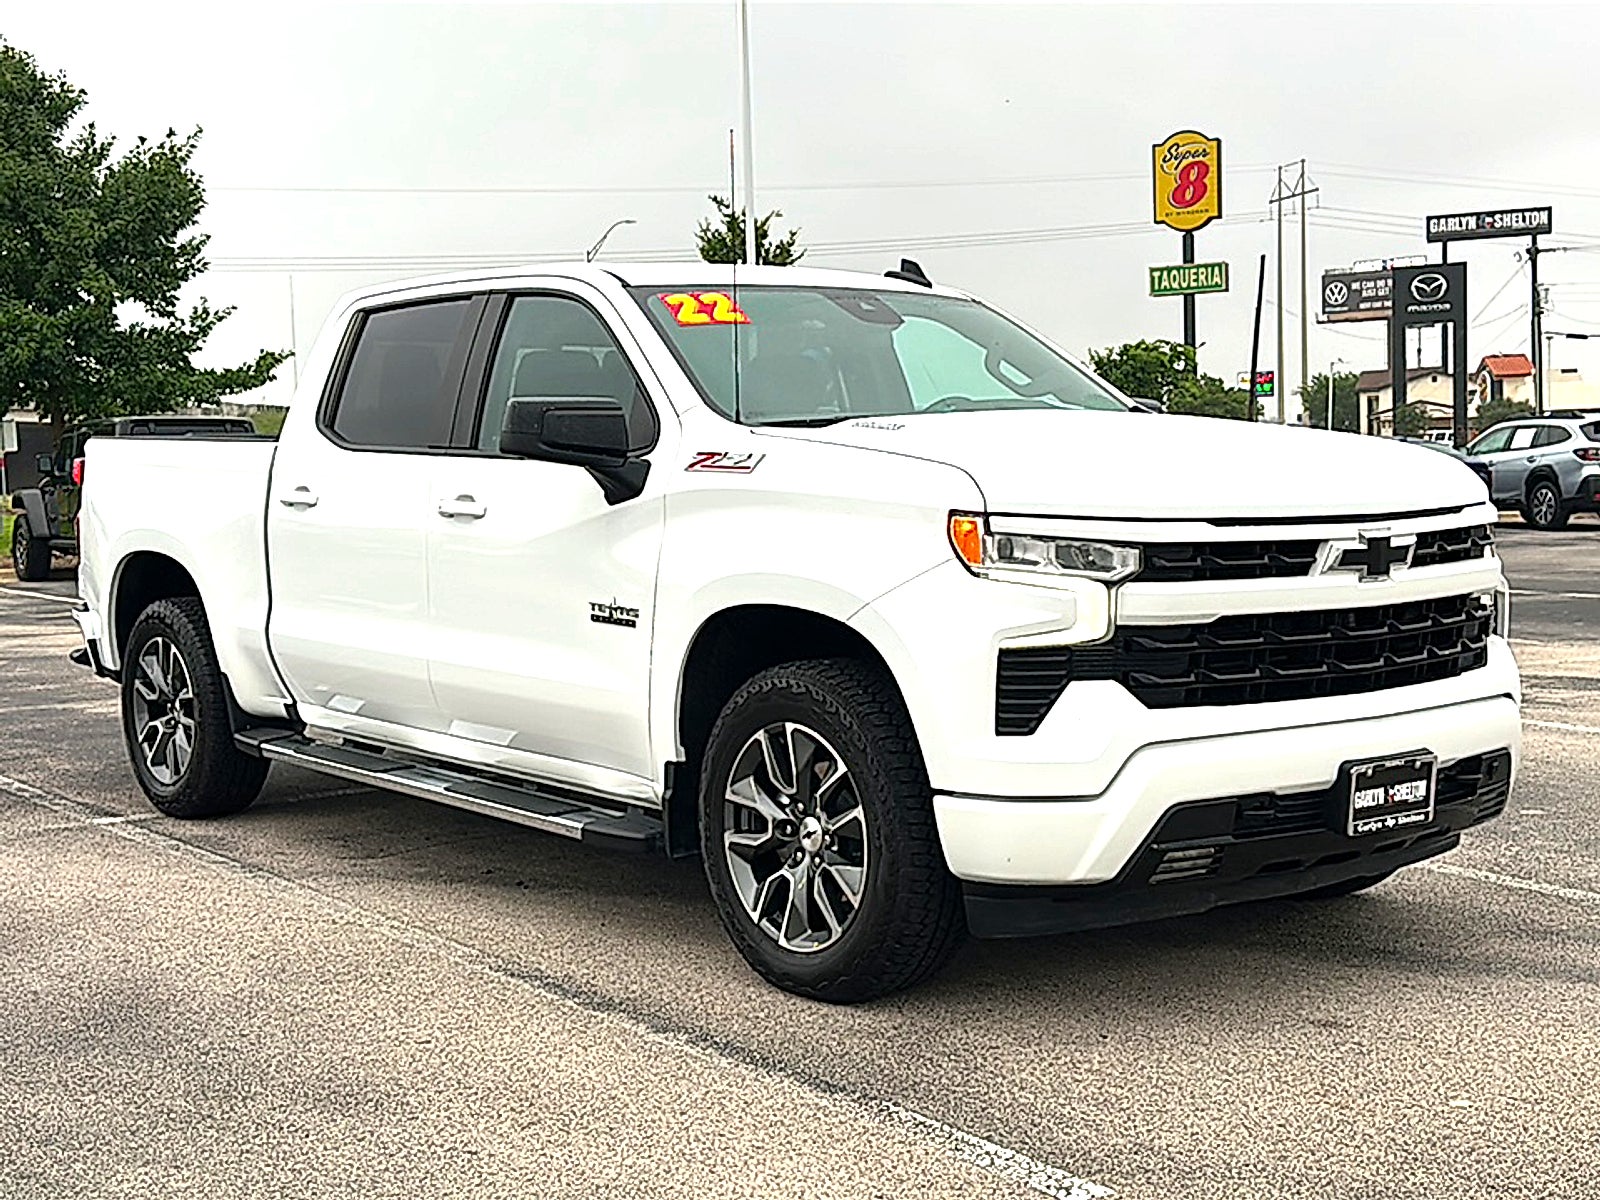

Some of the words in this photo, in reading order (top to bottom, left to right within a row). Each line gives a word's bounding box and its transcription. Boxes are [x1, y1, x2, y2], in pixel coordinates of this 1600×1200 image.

[1162, 142, 1210, 171] Super
[1169, 160, 1210, 208] 8
[1429, 215, 1477, 233] GARLYN
[1493, 210, 1549, 228] SHELTON
[1152, 265, 1222, 290] TAQUERIA
[664, 292, 745, 323] 22
